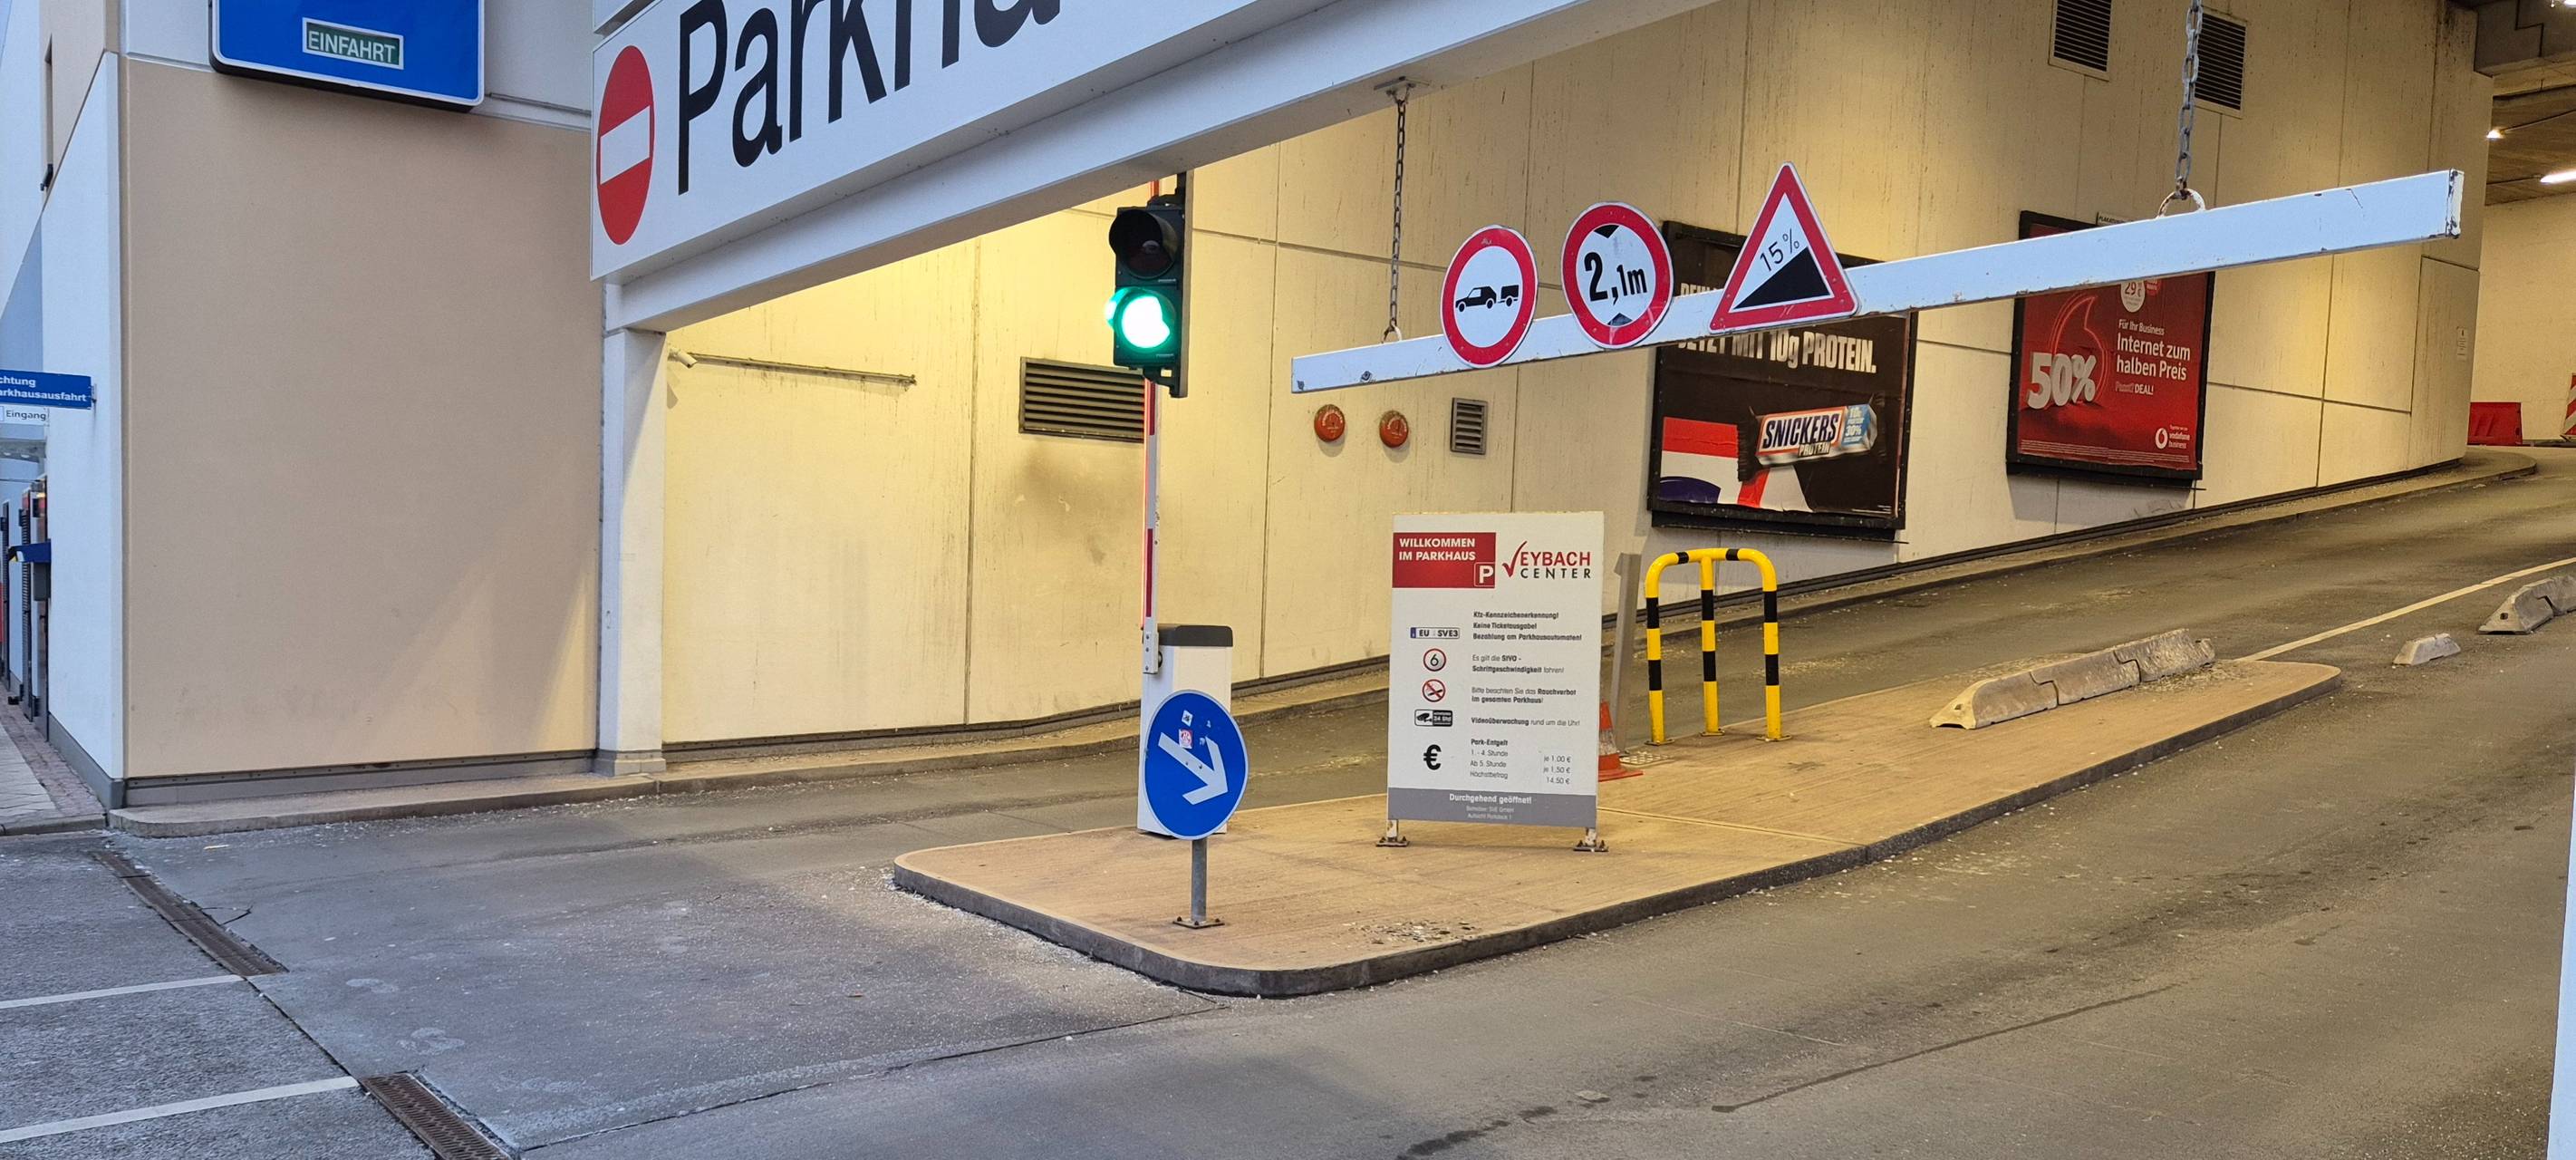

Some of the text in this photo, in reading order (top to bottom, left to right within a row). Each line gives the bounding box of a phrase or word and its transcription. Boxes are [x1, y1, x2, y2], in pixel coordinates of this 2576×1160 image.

[308, 30, 396, 63] EINFAHRT
[2118, 319, 2165, 335] Für Ihr Business
[1732, 332, 1765, 359] MIT
[1770, 329, 1799, 369] 10g
[1802, 331, 1877, 373] PROTEIN.
[2118, 332, 2191, 361] Internet zum
[2117, 354, 2187, 381] halben Preis
[2027, 352, 2097, 410] 50%
[2135, 383, 2154, 395] DEAL!
[5, 410, 46, 421] Eingang
[1762, 413, 1840, 450] SNICKERS
[1799, 441, 1830, 456] PROTEIN
[1399, 538, 1476, 547] WILLKOMMEN
[1399, 551, 1476, 561] IM PARKHAUS
[1479, 565, 1494, 584] P
[1520, 567, 1591, 579] CENTER
[1419, 629, 1459, 637] EU SVE3
[1472, 633, 1505, 641] Bezahlung
[1430, 653, 1439, 666] 6
[1471, 717, 1529, 726] Videoüberwachung
[1471, 739, 1508, 747] Park-Entgelt
[1423, 744, 1442, 770] €
[1567, 755, 1571, 763] €
[1449, 793, 1497, 803] Durchgehend
